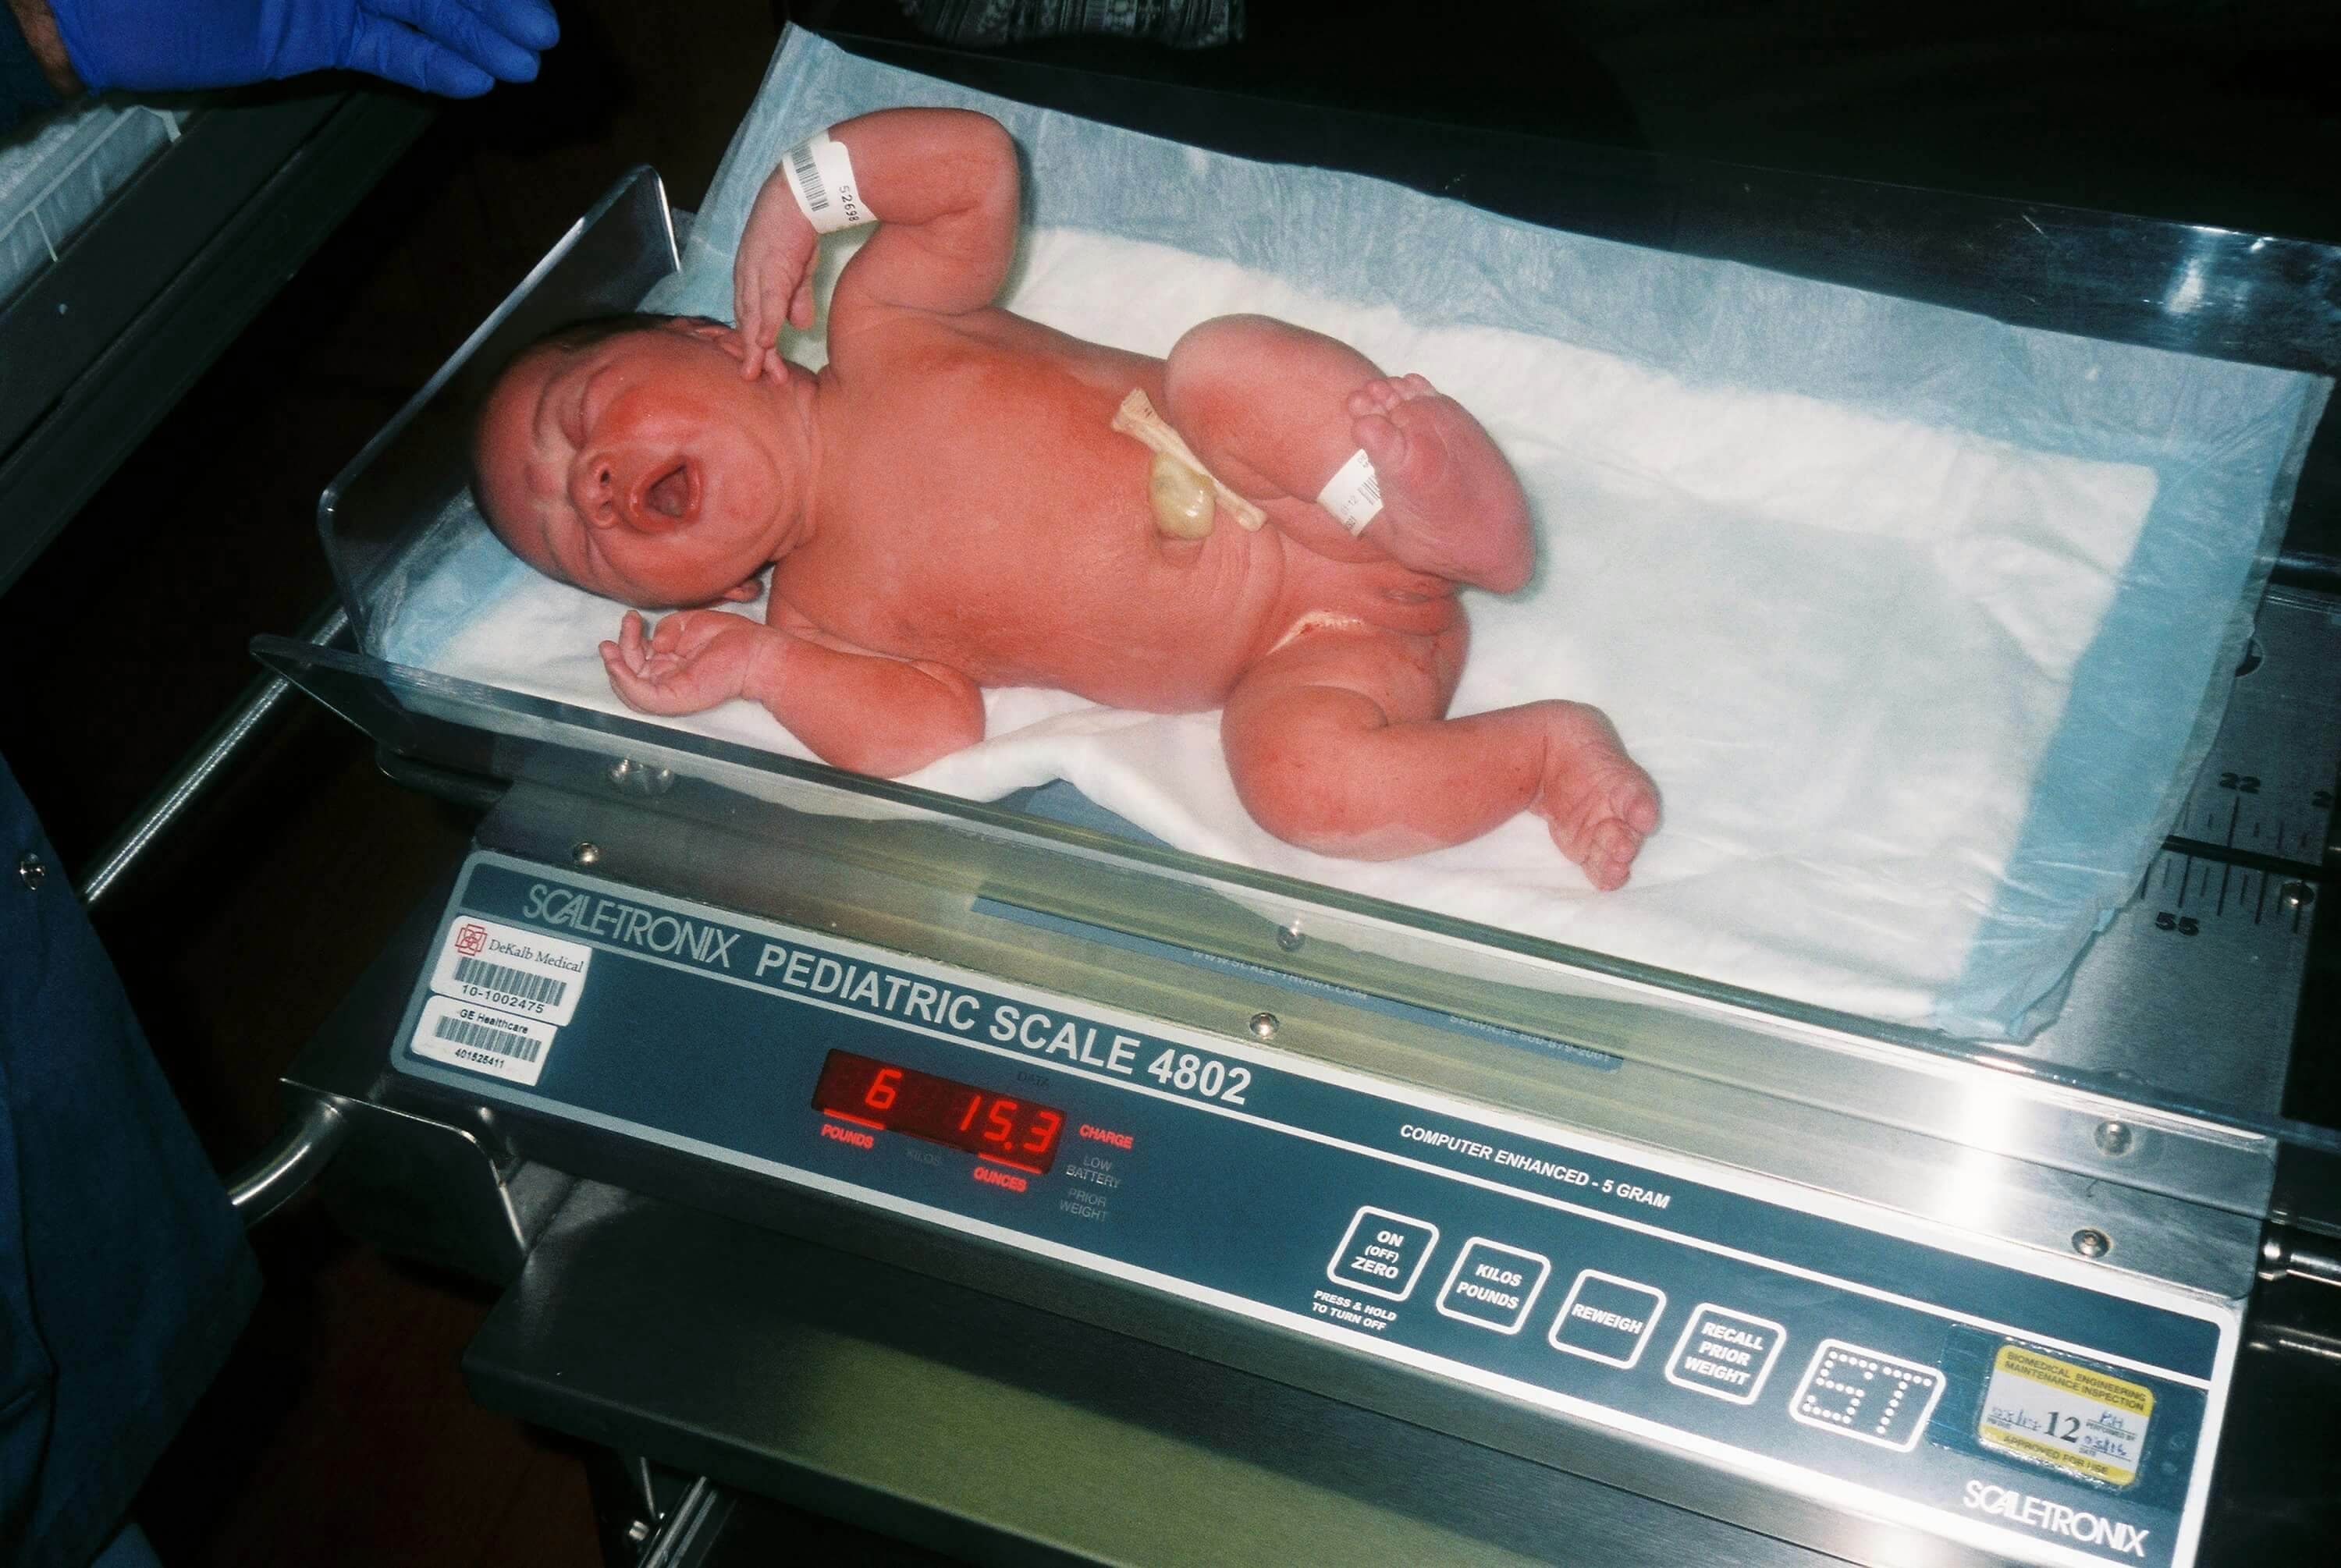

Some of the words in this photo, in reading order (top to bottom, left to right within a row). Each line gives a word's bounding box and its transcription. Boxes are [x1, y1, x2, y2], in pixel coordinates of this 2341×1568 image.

[839, 185, 859, 222] 52698
[2220, 772, 2261, 794] 22
[2155, 910, 2199, 936] 55
[488, 938, 535, 960] DeKalb
[535, 951, 584, 974] Medical
[462, 984, 545, 1014] 10-1002475
[459, 1008, 475, 1020] GE
[478, 1013, 528, 1034] Healthcare
[755, 942, 980, 1031] PEDIATRIC
[989, 1006, 1140, 1075] SCALE
[1147, 1049, 1252, 1105] 4802
[455, 1048, 506, 1068] 401525411
[865, 1068, 903, 1110] 6
[959, 1094, 1064, 1154] 15.3
[820, 1123, 875, 1150] POUNDS
[1078, 1123, 1134, 1150] CHARGE
[1066, 1164, 1121, 1188] BATTERY
[1083, 1155, 1114, 1172] LOW
[1400, 1124, 1493, 1160] COMPUTER
[1494, 1148, 1589, 1187] ENHANCED
[1602, 1179, 1614, 1194] 5
[1616, 1183, 1671, 1209] GRAM
[973, 1166, 1028, 1194] OUNCES
[1060, 1199, 1108, 1222] WEIGHT
[1067, 1188, 1107, 1206] PRIOR
[1377, 1230, 1404, 1247] ON
[1351, 1257, 1399, 1279] ZERO
[1365, 1244, 1400, 1264] (OFF)
[1476, 1264, 1522, 1287] KILOS
[1313, 1290, 1352, 1309] PRESS
[1353, 1300, 1362, 1311] &
[1363, 1304, 1398, 1322] HOLD
[1456, 1282, 1520, 1310] POUNDS
[1312, 1302, 1325, 1313] TO
[1326, 1305, 1361, 1324] TURN
[1362, 1317, 1388, 1332] OFF
[1572, 1303, 1643, 1335] REWEIGH
[1702, 1321, 1764, 1351] RECALL
[1698, 1339, 1750, 1367] PRIOR
[1683, 1357, 1750, 1386] WEIGHT
[2004, 1360, 2079, 1390] MAINTENANCE
[2082, 1384, 2144, 1411] INSPECTION
[2006, 1350, 2070, 1378] BIOMEDICAL
[2075, 1374, 2147, 1402] ENGINEERING
[2044, 1410, 2081, 1443] 12
[2003, 1435, 2061, 1460] APPROVED
[2063, 1449, 2085, 1468] FOR
[2087, 1460, 2109, 1475] USE
